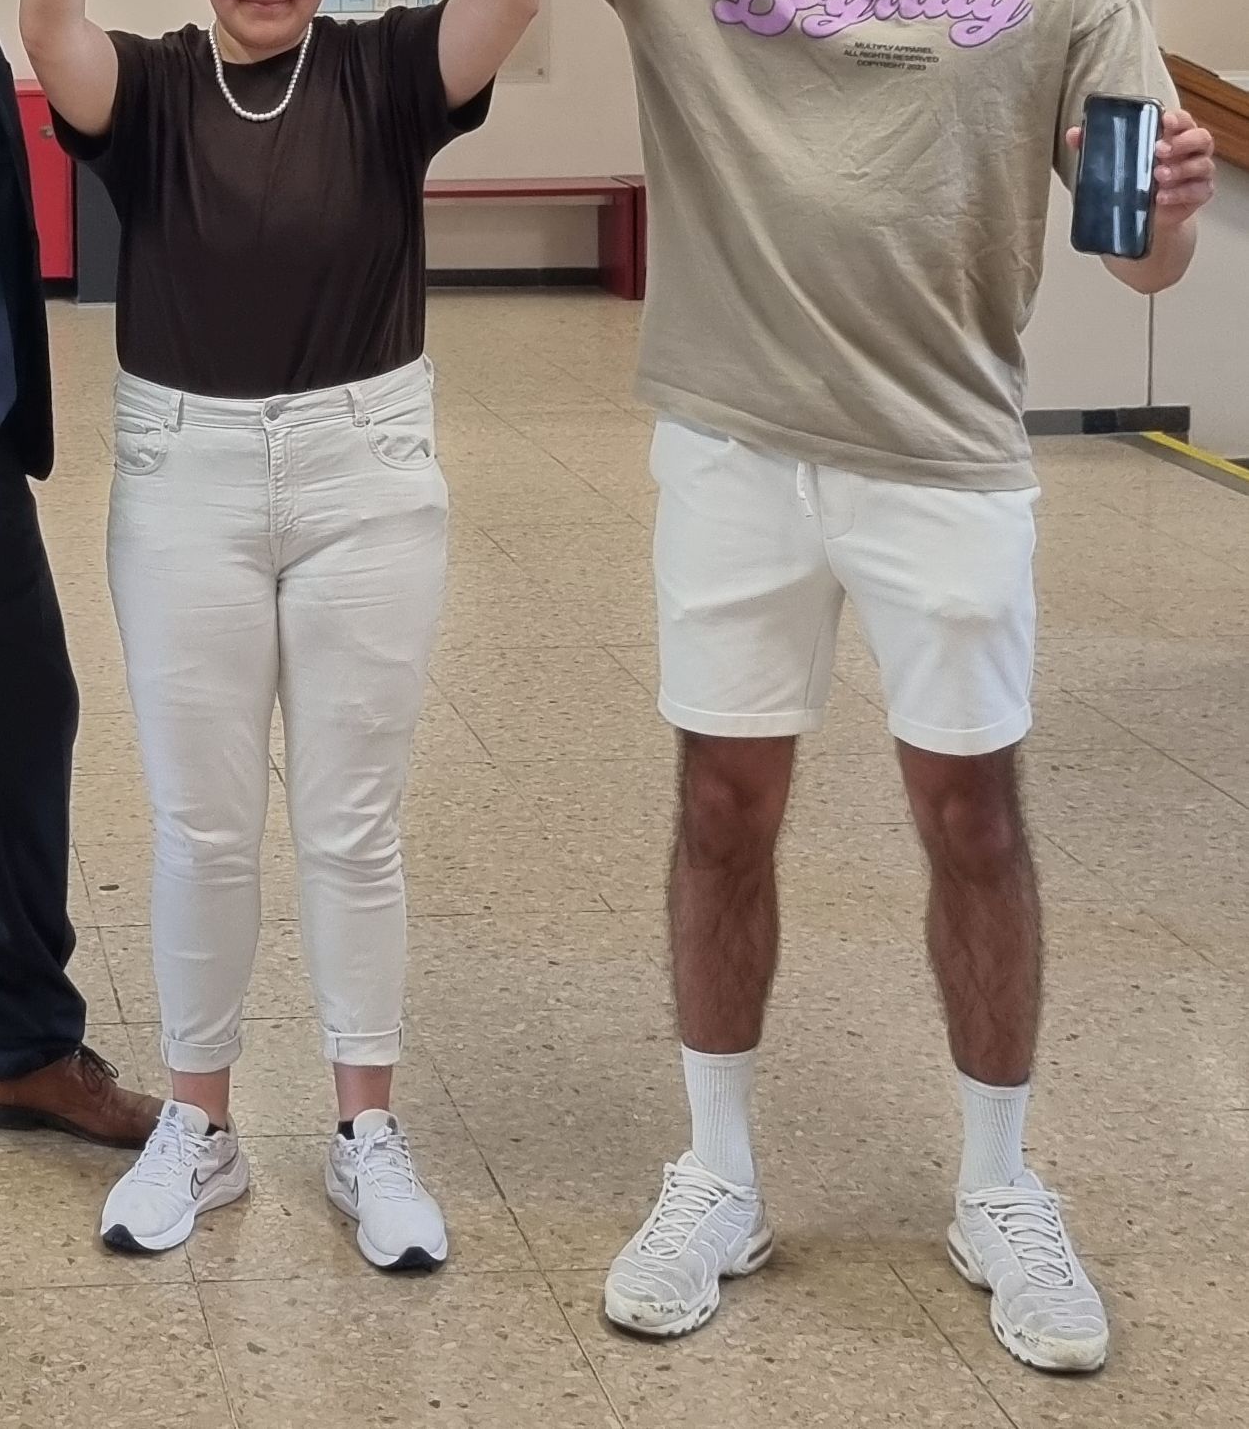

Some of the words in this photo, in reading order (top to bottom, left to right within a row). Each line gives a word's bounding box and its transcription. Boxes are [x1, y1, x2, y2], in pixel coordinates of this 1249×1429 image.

[843, 49, 858, 57] ALL
[859, 52, 891, 60] RIGHTS
[893, 54, 939, 63] RESERVED
